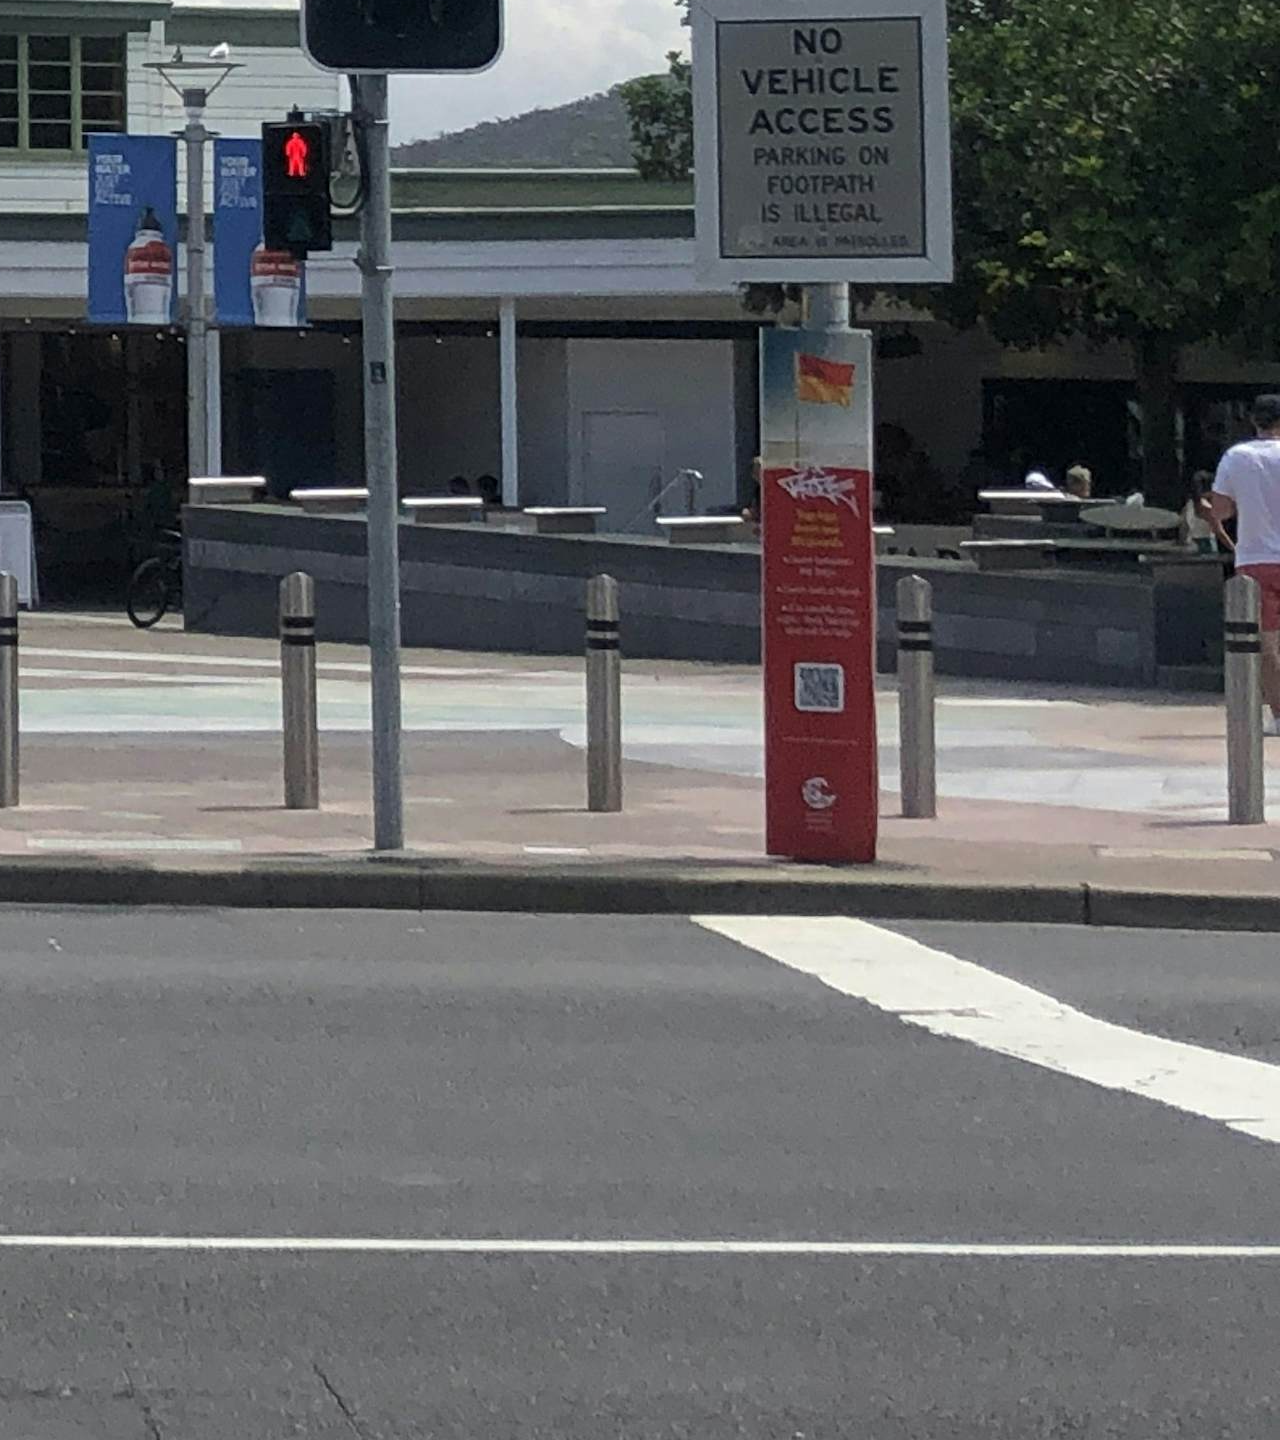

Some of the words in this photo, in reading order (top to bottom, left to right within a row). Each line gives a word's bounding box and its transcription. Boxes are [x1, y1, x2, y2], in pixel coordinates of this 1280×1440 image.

[793, 28, 843, 55] NO
[741, 67, 900, 95] VEHICLE
[748, 106, 895, 135] ACCESS
[753, 146, 846, 166] PARKING
[858, 146, 889, 165] ON
[767, 174, 875, 195] FOOTPATH
[760, 204, 781, 224] IS
[794, 203, 883, 224] ILLEGAL
[771, 235, 809, 248] AREA
